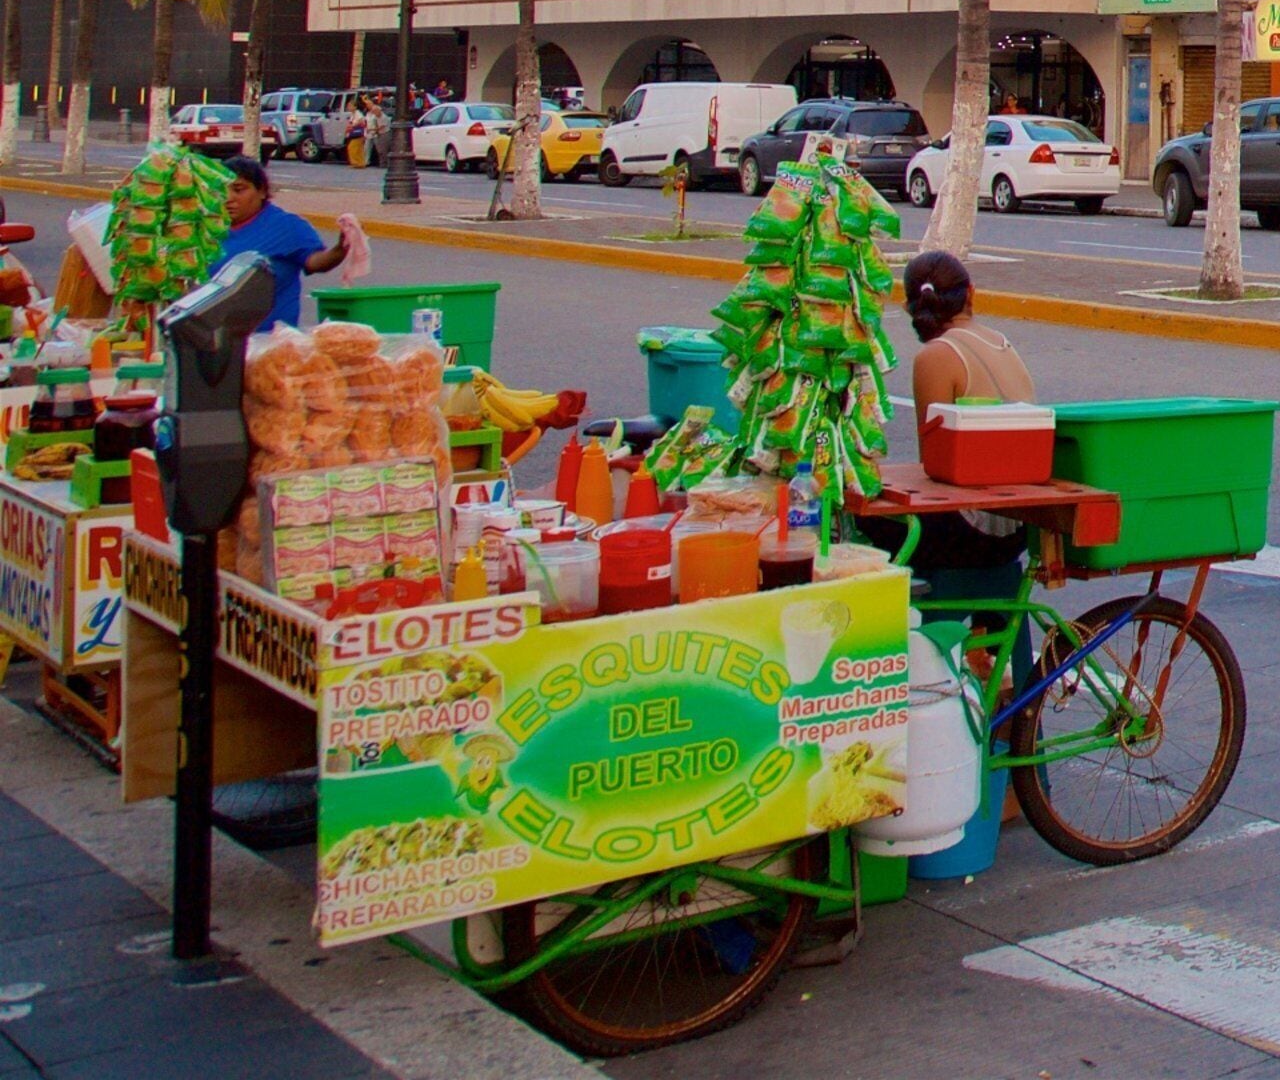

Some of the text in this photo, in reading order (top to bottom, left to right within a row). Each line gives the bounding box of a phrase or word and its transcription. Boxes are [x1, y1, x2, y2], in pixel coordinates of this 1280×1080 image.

[332, 606, 523, 661] ELOTES
[332, 672, 444, 709] TOSTITO
[497, 631, 791, 746] ESQUITES
[834, 655, 907, 682] Sopas
[329, 700, 491, 745] PREPARADO
[610, 697, 692, 742] DEL
[781, 684, 908, 720] Maruchans
[781, 709, 908, 744] Preparadas
[570, 738, 739, 800] PUERTO
[497, 745, 795, 863] ELOTES
[318, 846, 530, 903] CHICHARRONES
[318, 881, 494, 931] PREPARADOS
